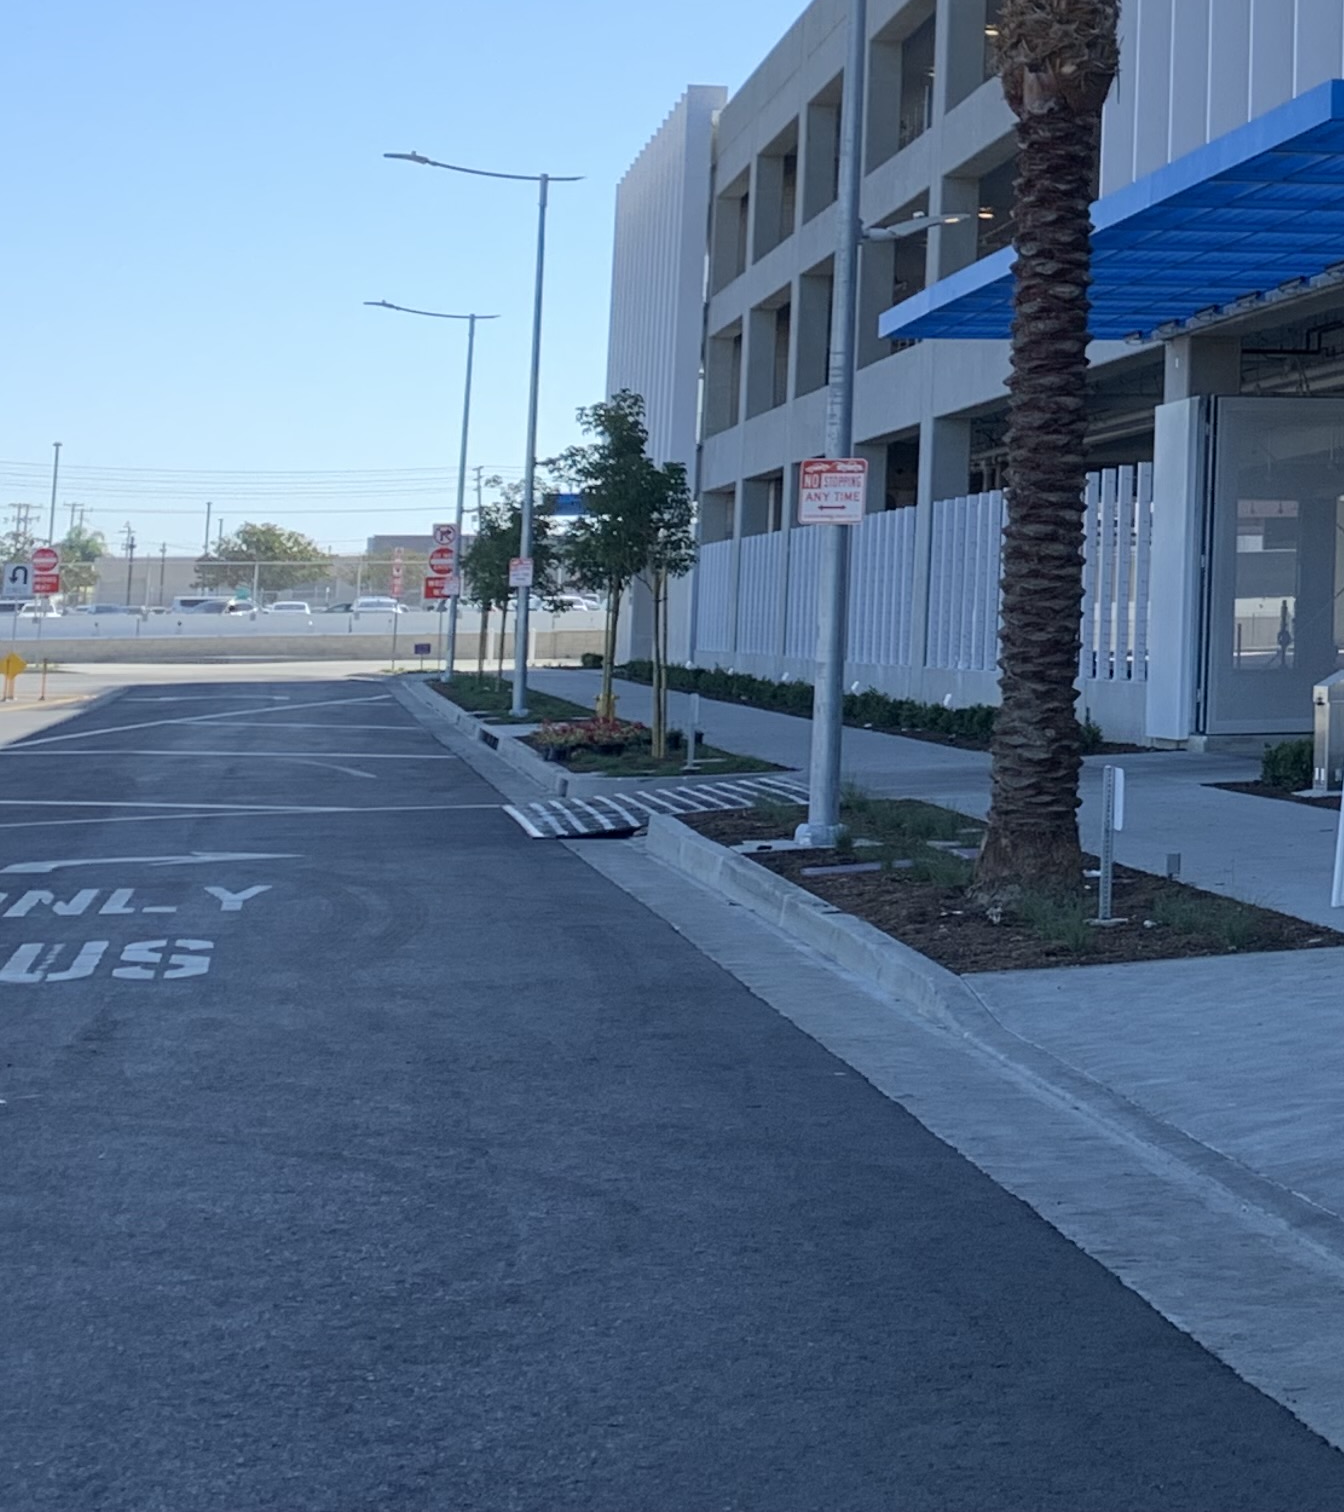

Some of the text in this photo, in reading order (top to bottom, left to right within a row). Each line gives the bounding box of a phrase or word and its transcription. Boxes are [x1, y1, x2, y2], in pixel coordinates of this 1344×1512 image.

[804, 473, 862, 488] NO STOPPING
[805, 491, 860, 502] ANY TIME
[0, 884, 273, 918] NLY
